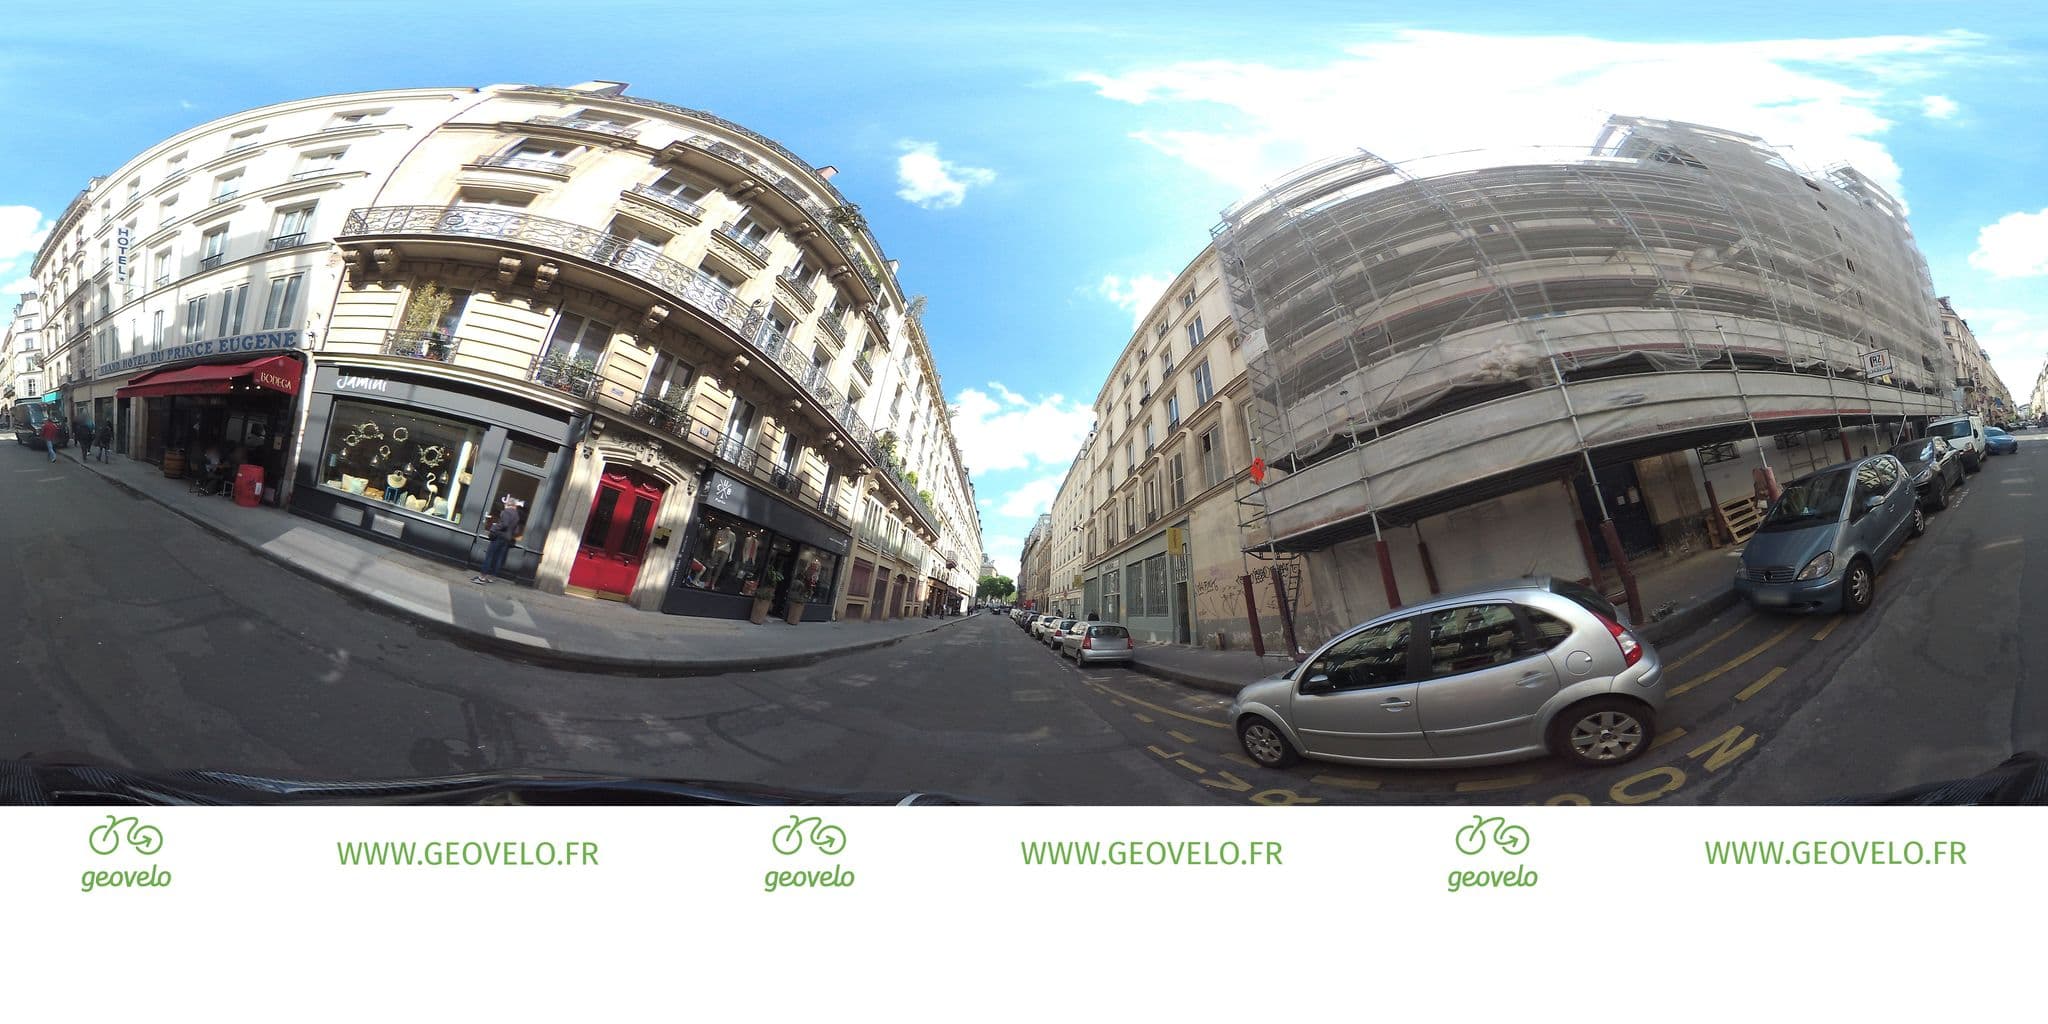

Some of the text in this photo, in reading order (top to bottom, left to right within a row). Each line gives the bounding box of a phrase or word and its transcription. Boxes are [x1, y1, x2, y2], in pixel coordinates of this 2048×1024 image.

[117, 228, 129, 275] HOTEL
[123, 354, 148, 369] HOTEL
[151, 351, 165, 363] DU
[168, 342, 213, 361] PRINCE
[260, 372, 292, 391] BODEGA
